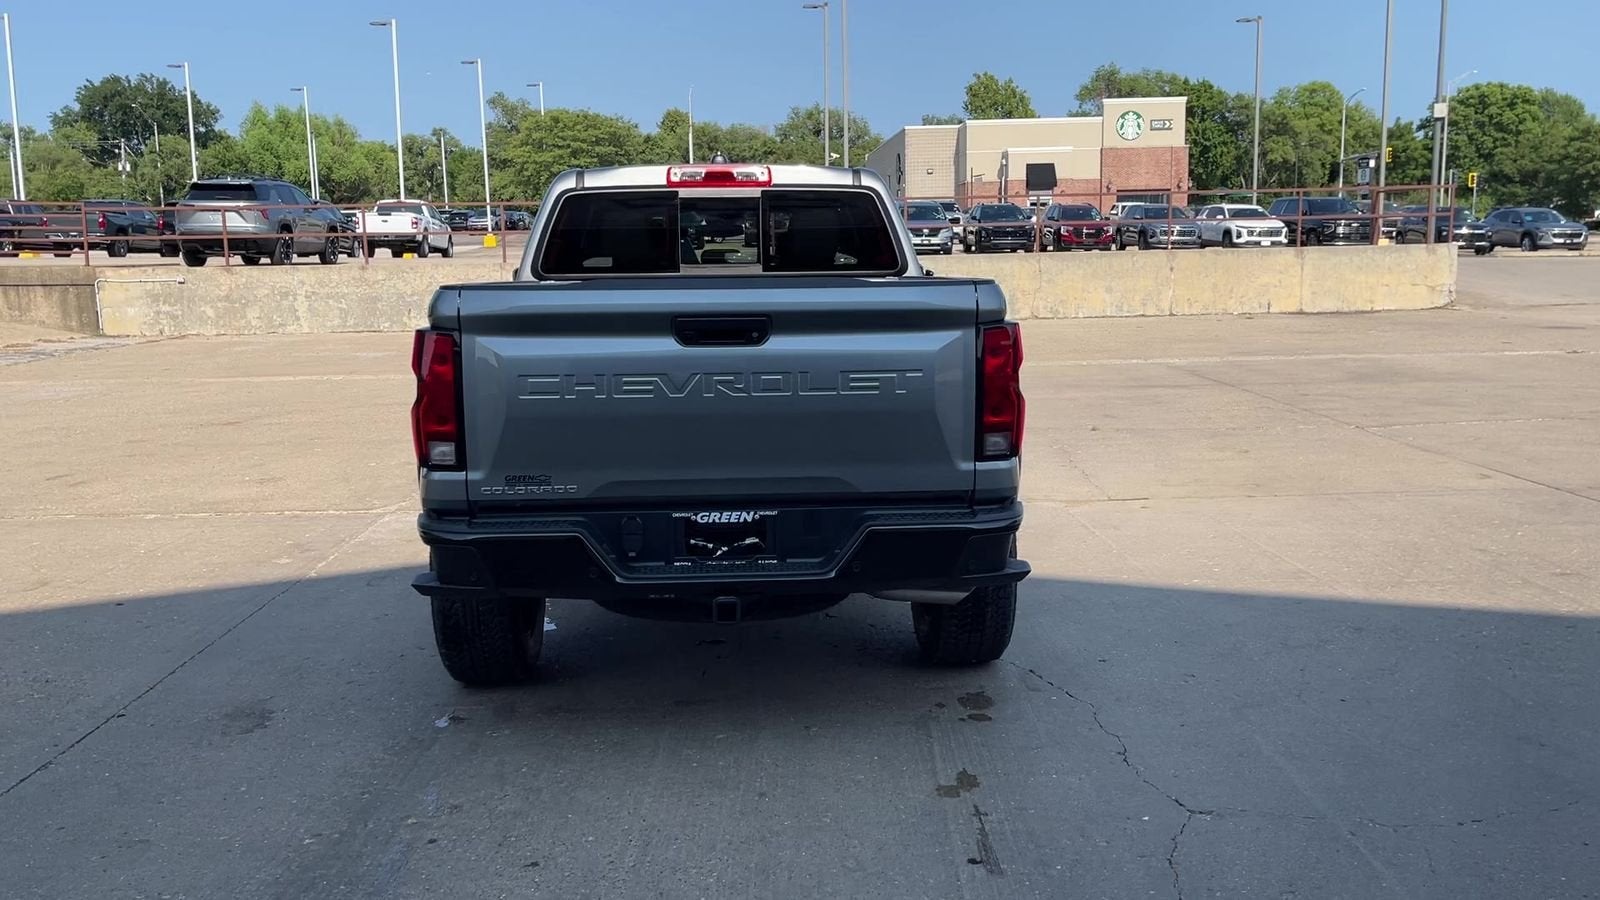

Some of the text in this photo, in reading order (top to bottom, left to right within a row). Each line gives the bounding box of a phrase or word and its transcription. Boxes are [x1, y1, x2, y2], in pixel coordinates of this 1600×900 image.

[517, 368, 924, 399] CHEVROLET
[504, 474, 536, 483] GREEN
[480, 485, 578, 494] COLORADO
[696, 511, 755, 523] GREEN
